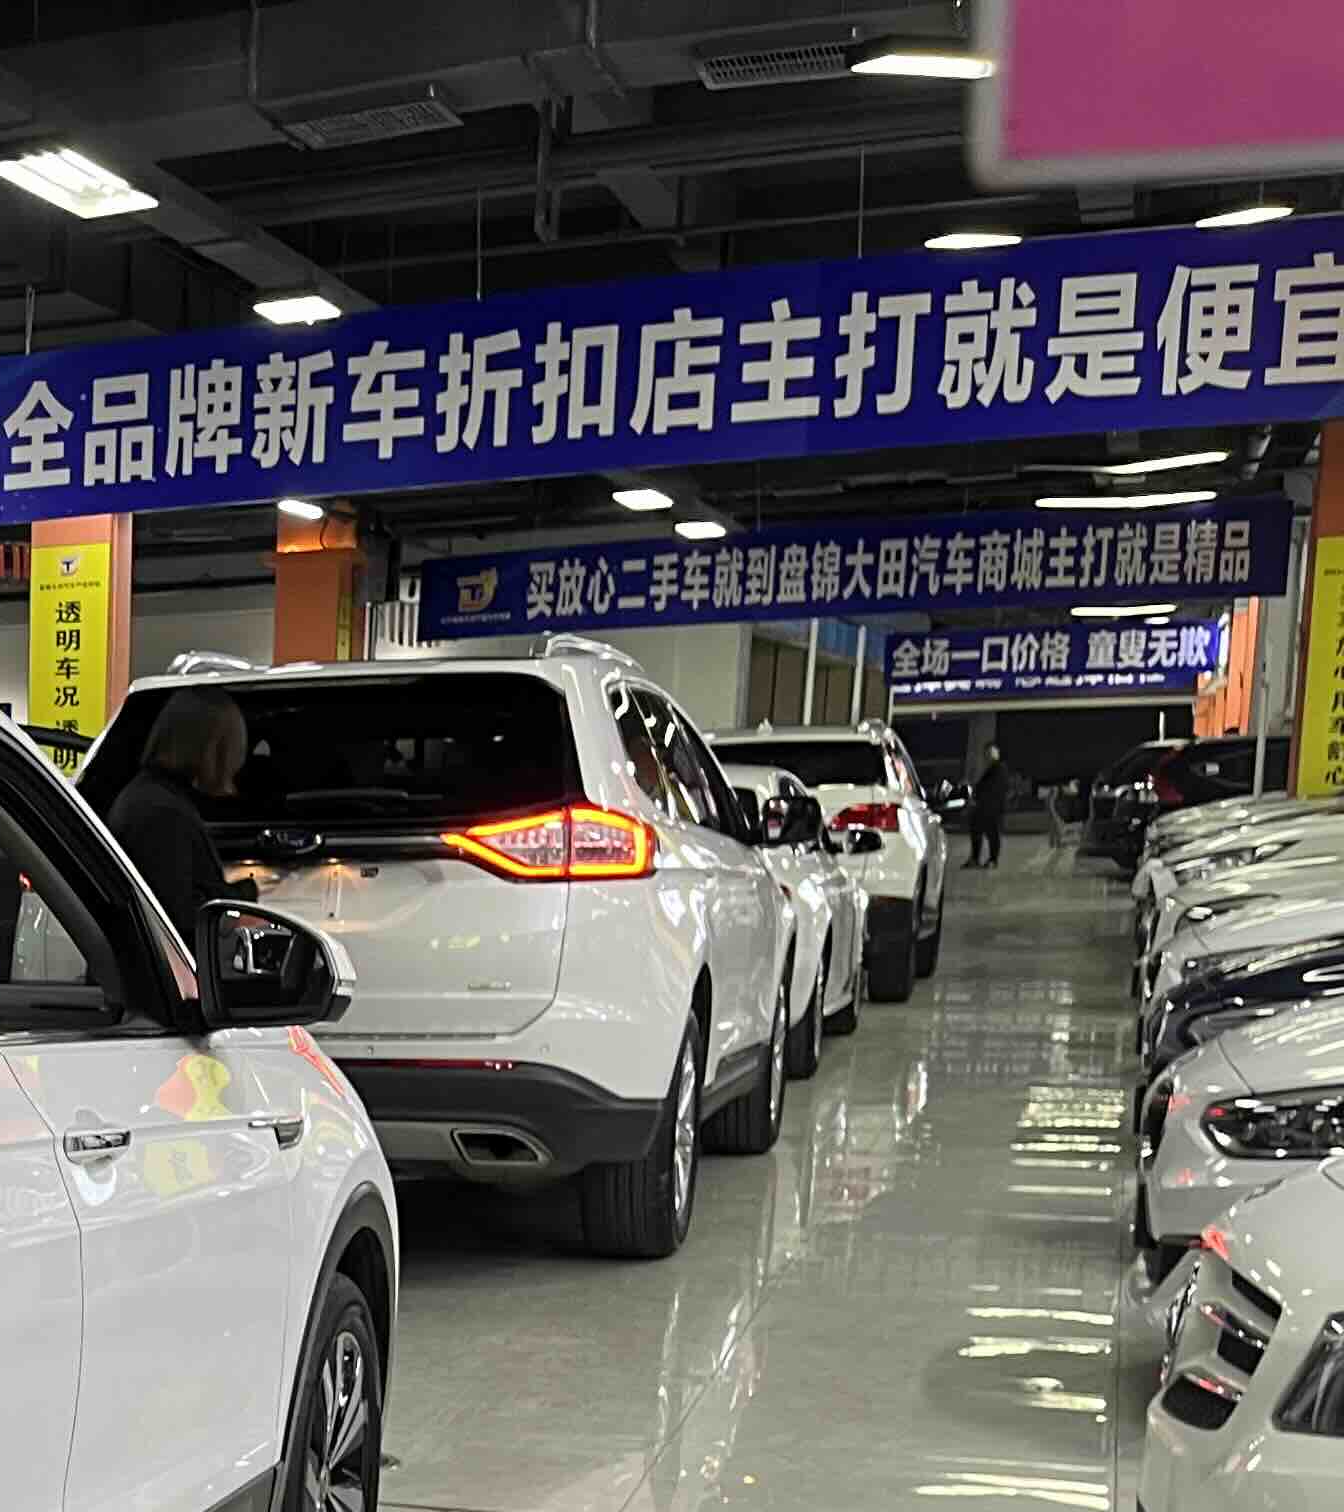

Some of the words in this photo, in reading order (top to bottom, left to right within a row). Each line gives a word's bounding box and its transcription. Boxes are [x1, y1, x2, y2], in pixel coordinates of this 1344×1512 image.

[2, 251, 1344, 491] 全品牌新车折扣店主打就是便宜
[525, 519, 1251, 621] 买放心二手车就到盘锦大田汽车商城主打就是精品
[53, 600, 82, 708] 透明车况
[891, 633, 1071, 678] 全场一口价格
[1085, 625, 1208, 670] 童叟无欺
